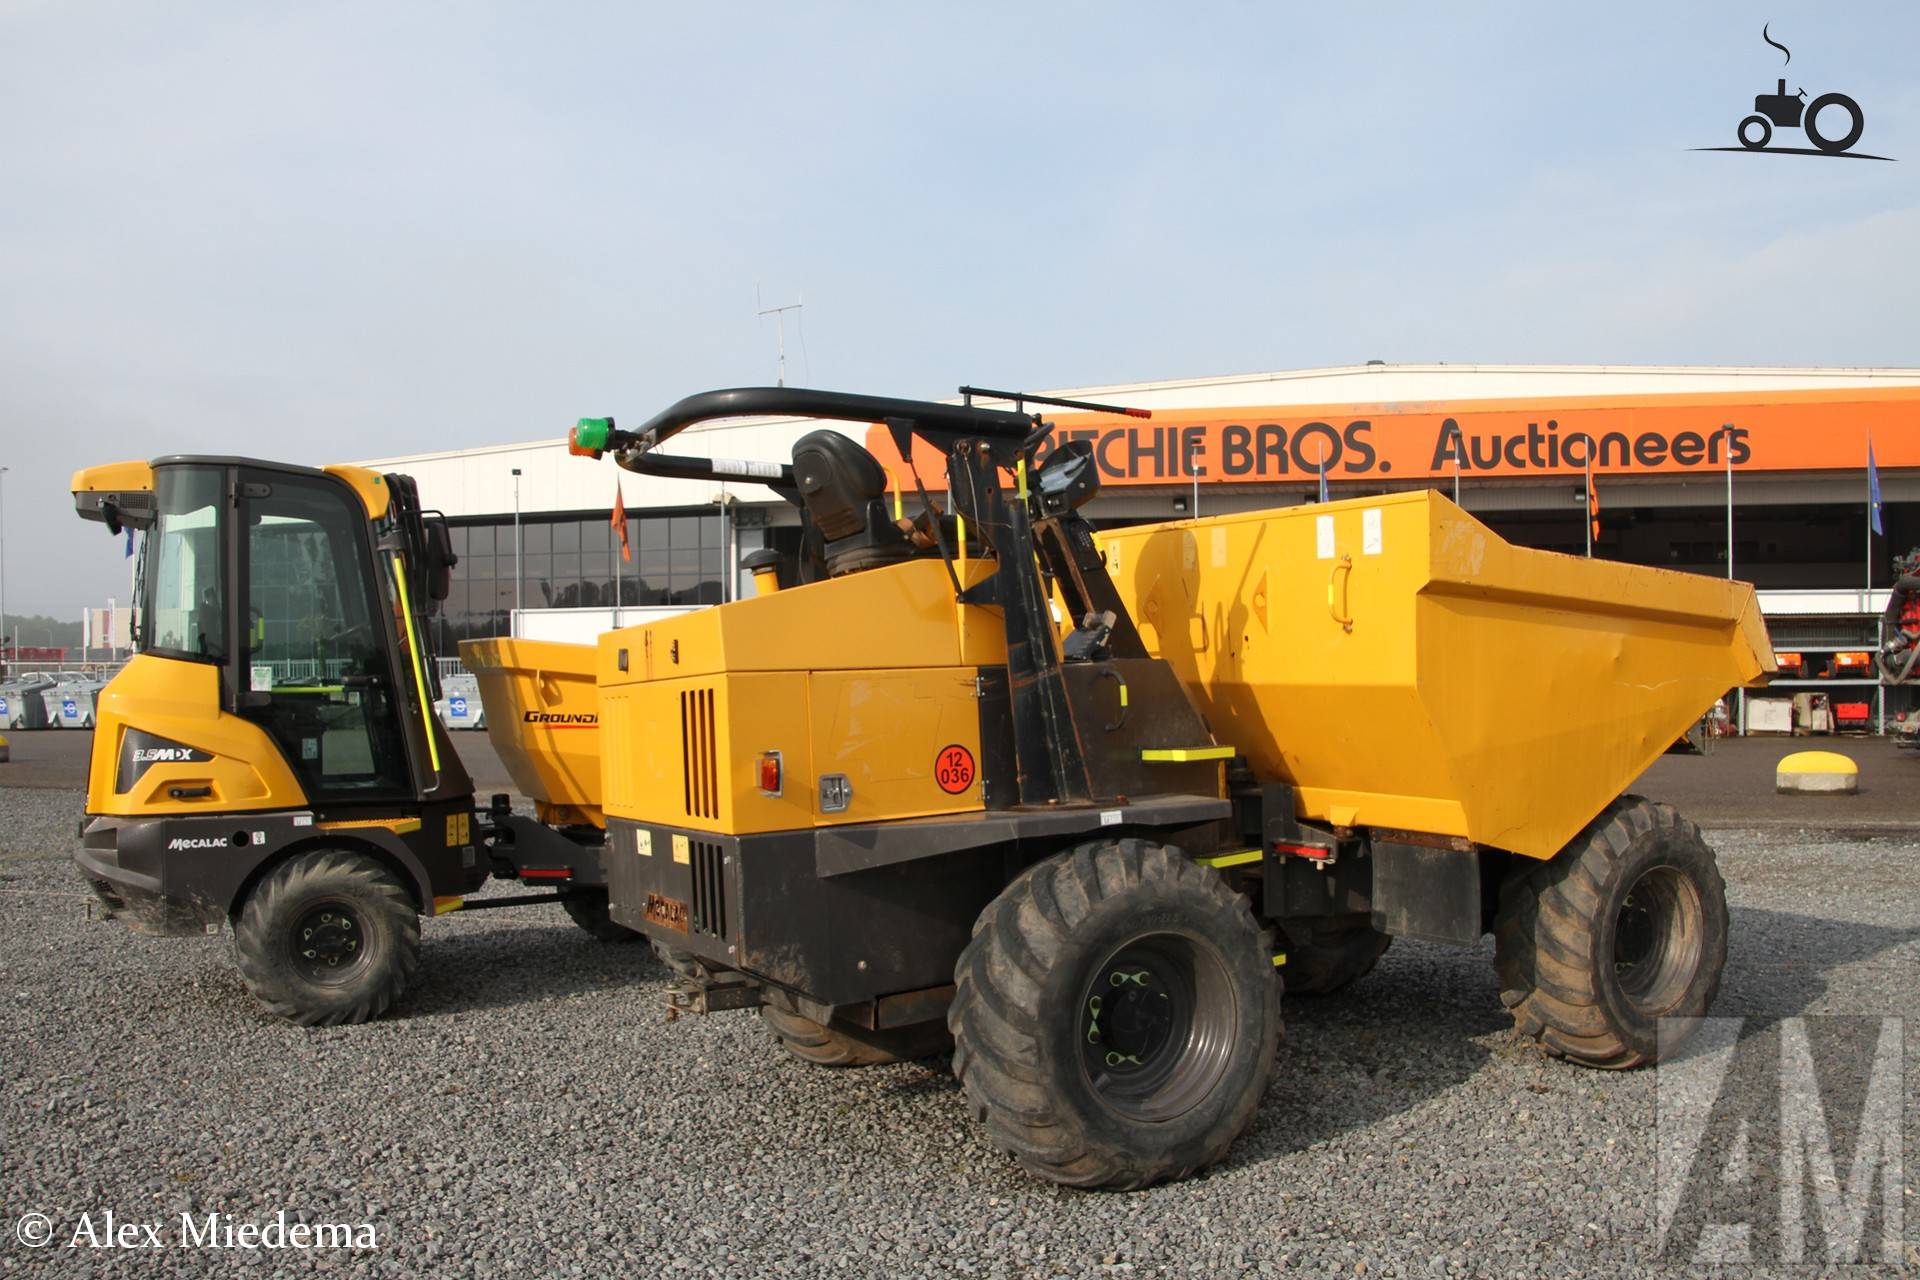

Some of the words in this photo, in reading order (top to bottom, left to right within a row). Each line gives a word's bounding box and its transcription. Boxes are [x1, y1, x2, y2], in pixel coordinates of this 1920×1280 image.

[1222, 421, 1392, 475] BROS.
[1430, 418, 1751, 471] Auctioneers
[946, 751, 963, 767] 12
[941, 767, 970, 784] 036
